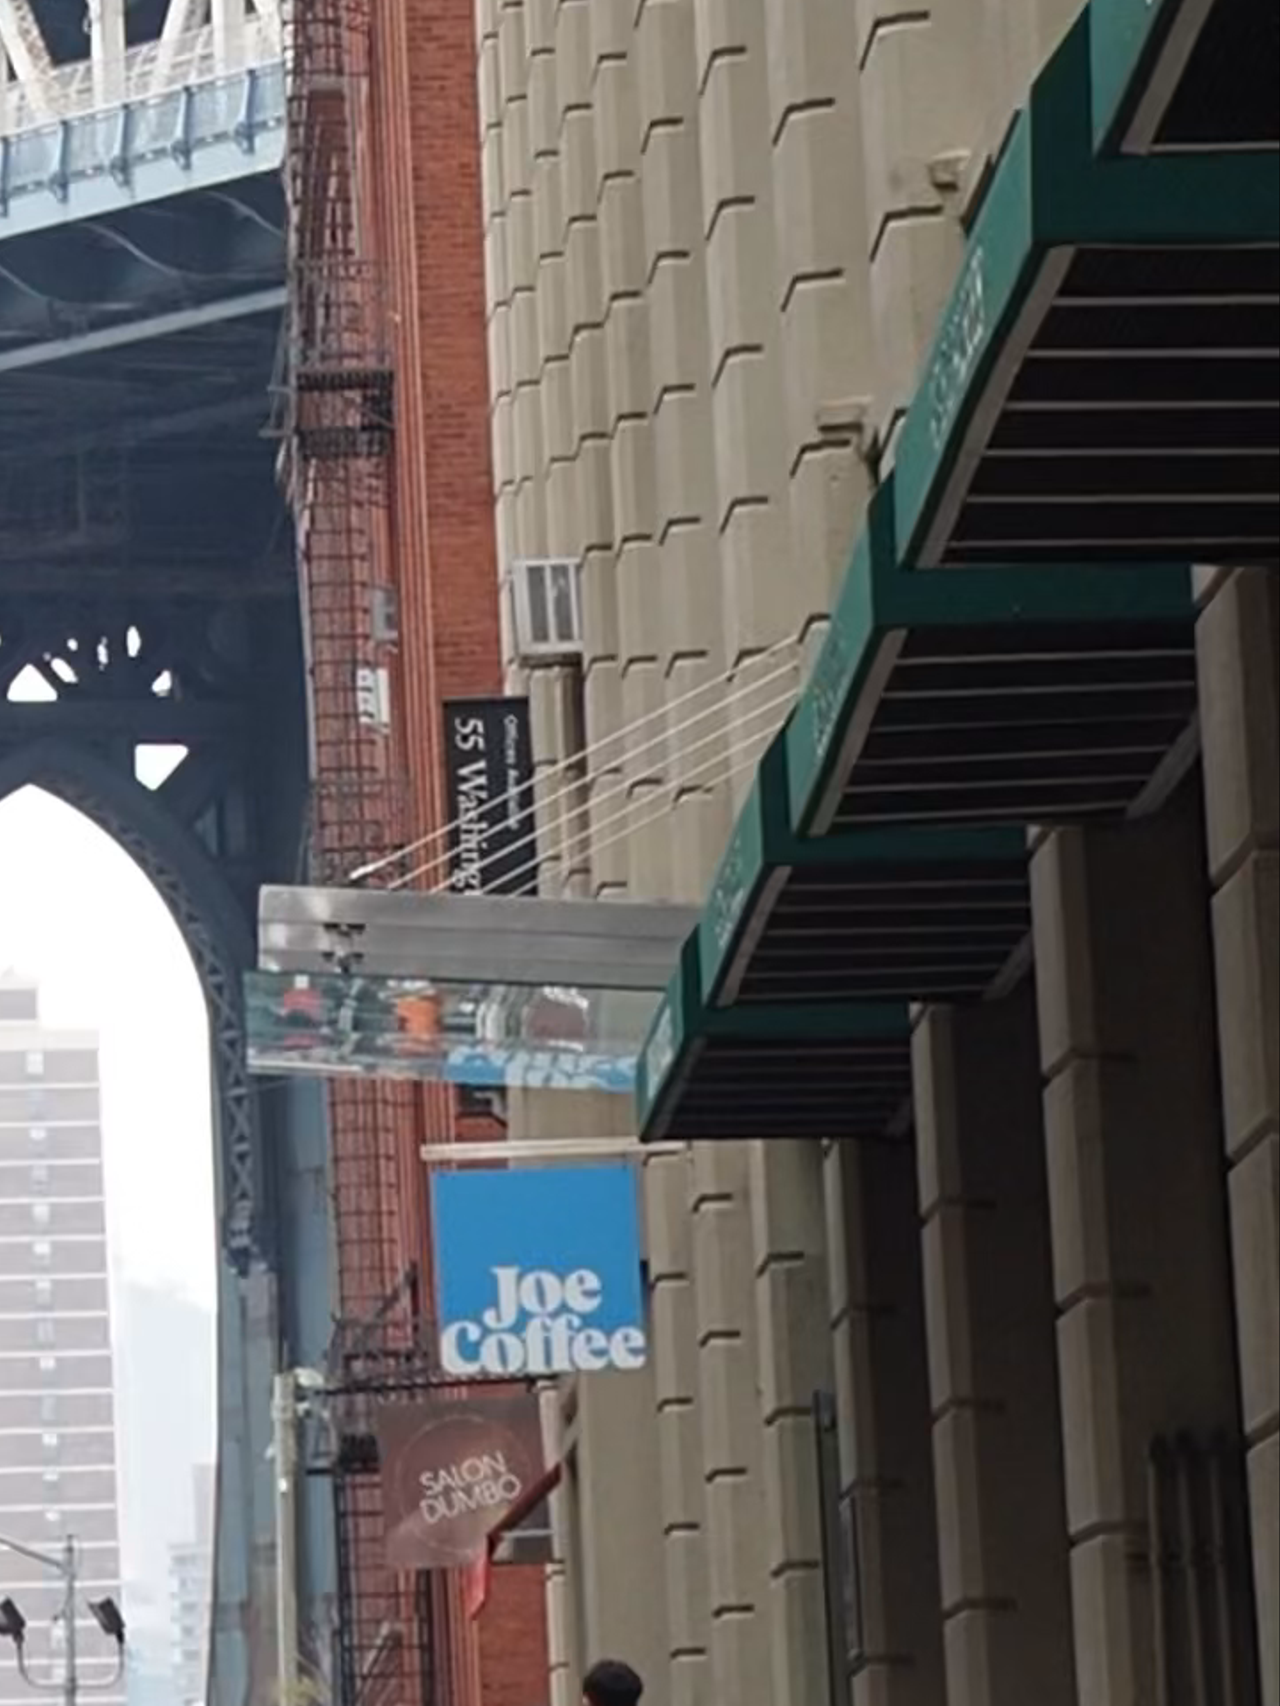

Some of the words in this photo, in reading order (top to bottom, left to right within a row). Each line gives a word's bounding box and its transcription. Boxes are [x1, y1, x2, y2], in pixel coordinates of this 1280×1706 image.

[455, 717, 485, 751] 55
[483, 1264, 602, 1329] Joe
[441, 1313, 647, 1375] Coffee
[419, 1450, 507, 1495] SALON
[419, 1472, 522, 1524] DUMBO
